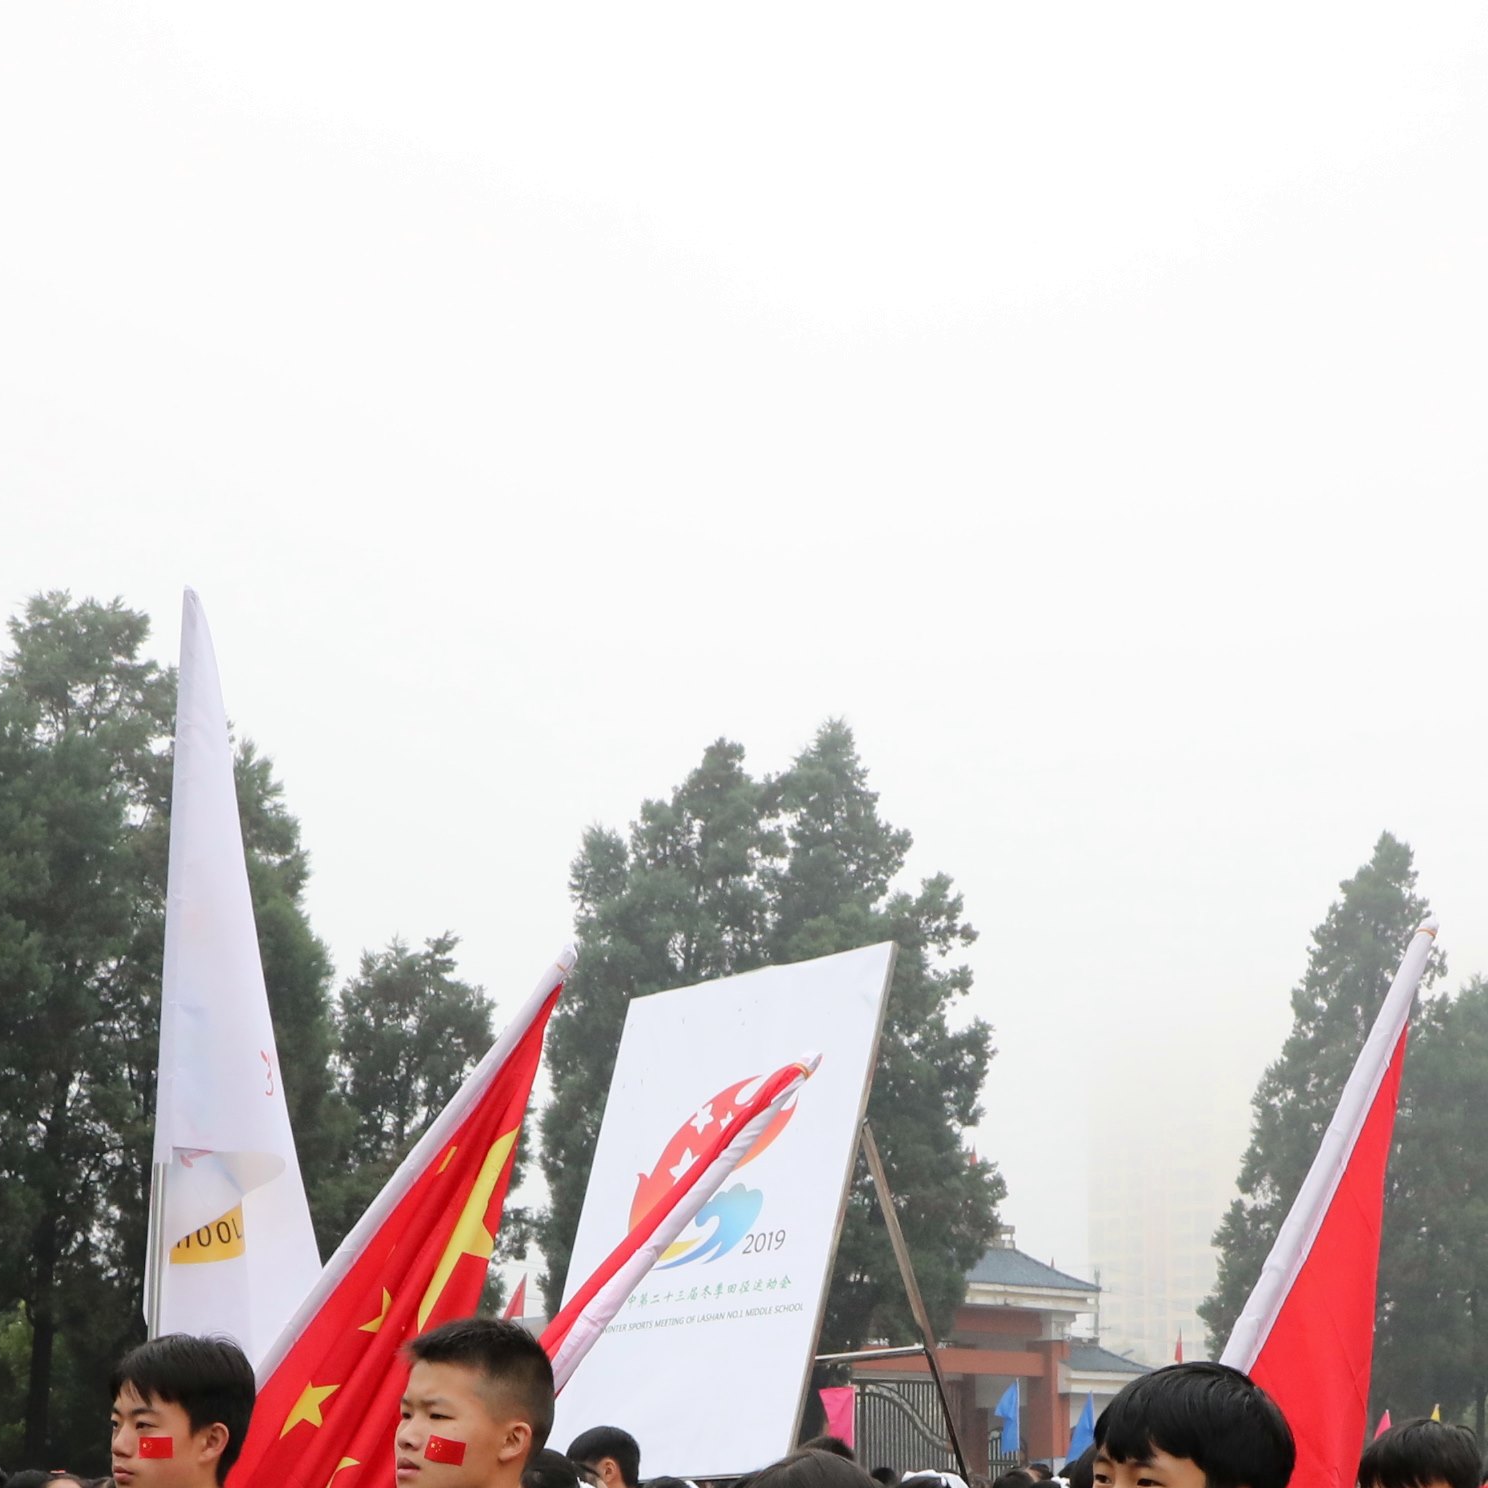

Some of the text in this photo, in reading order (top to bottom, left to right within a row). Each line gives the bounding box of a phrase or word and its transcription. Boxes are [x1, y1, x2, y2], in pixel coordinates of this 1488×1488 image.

[742, 1230, 786, 1254] 2019
[628, 1320, 652, 1331] SPORTS
[654, 1317, 684, 1328] MEETING
[686, 1315, 696, 1324] OF
[745, 1306, 772, 1317] MIDDLE
[774, 1302, 803, 1313] SCHOOL
